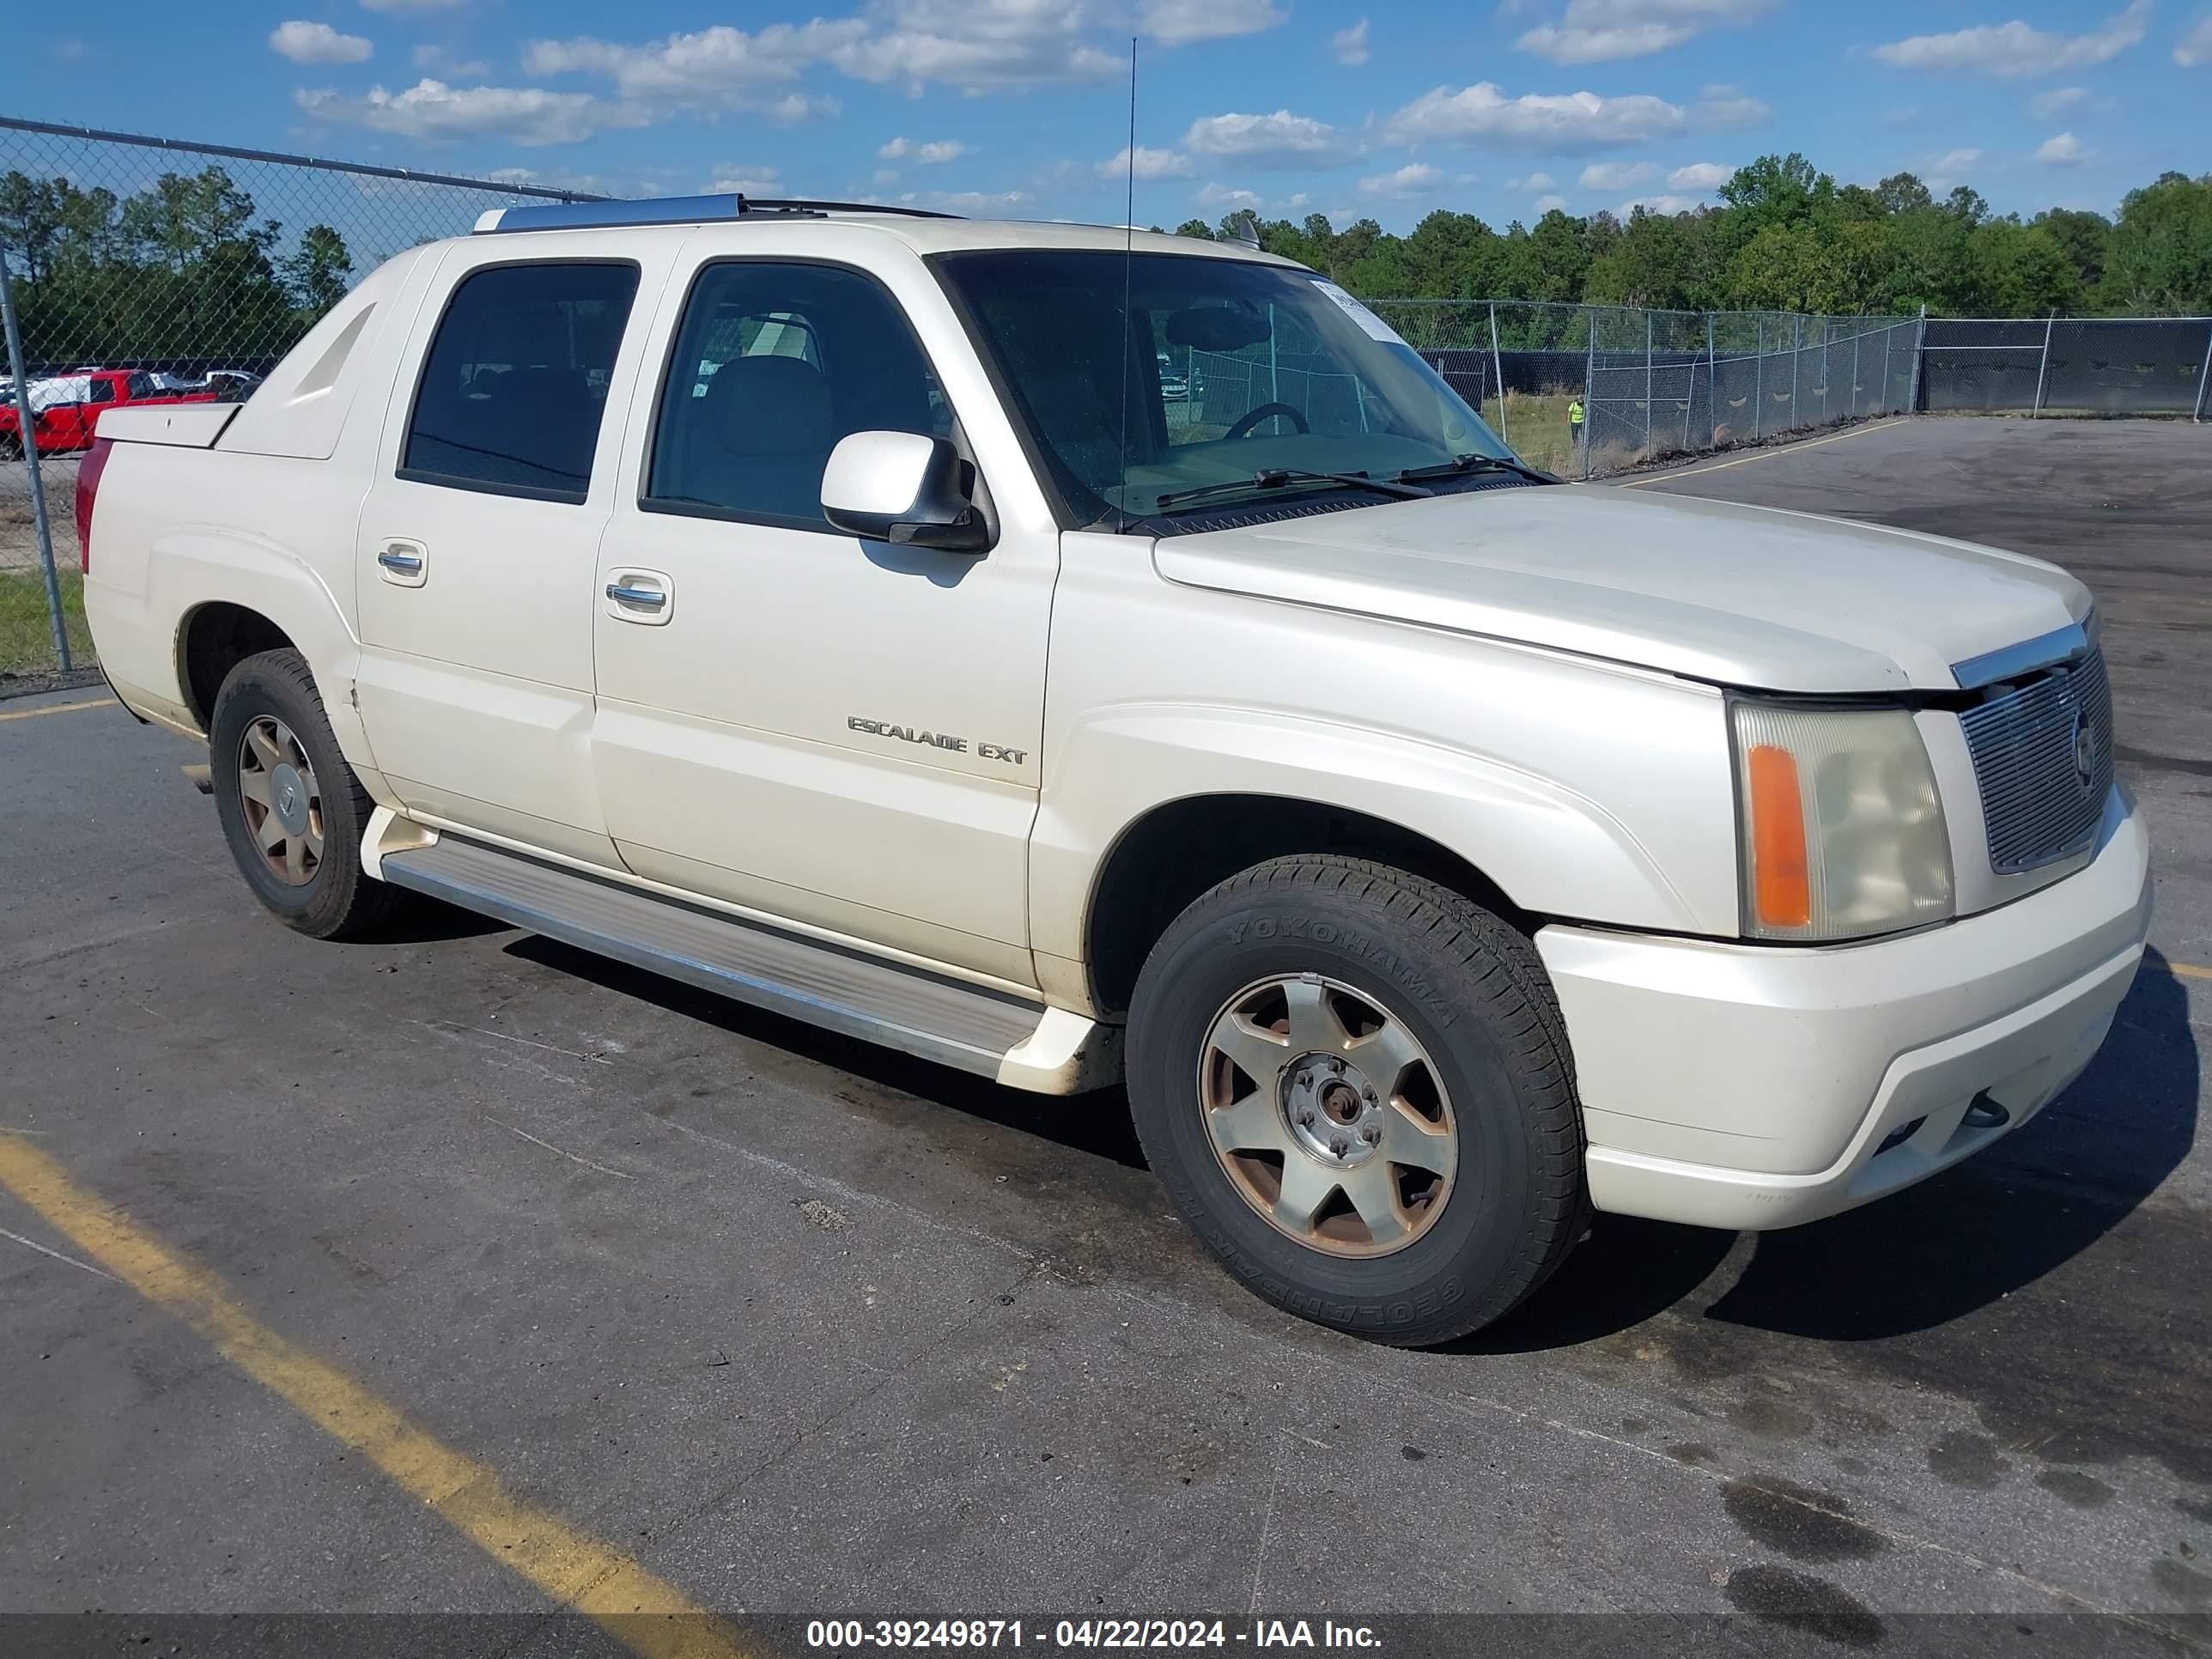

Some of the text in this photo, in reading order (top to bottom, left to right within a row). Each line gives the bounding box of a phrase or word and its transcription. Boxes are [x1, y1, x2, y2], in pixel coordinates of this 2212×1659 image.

[847, 715, 1029, 765] ESCALADE EXT
[1226, 915, 1461, 1030] YOKOHAMA
